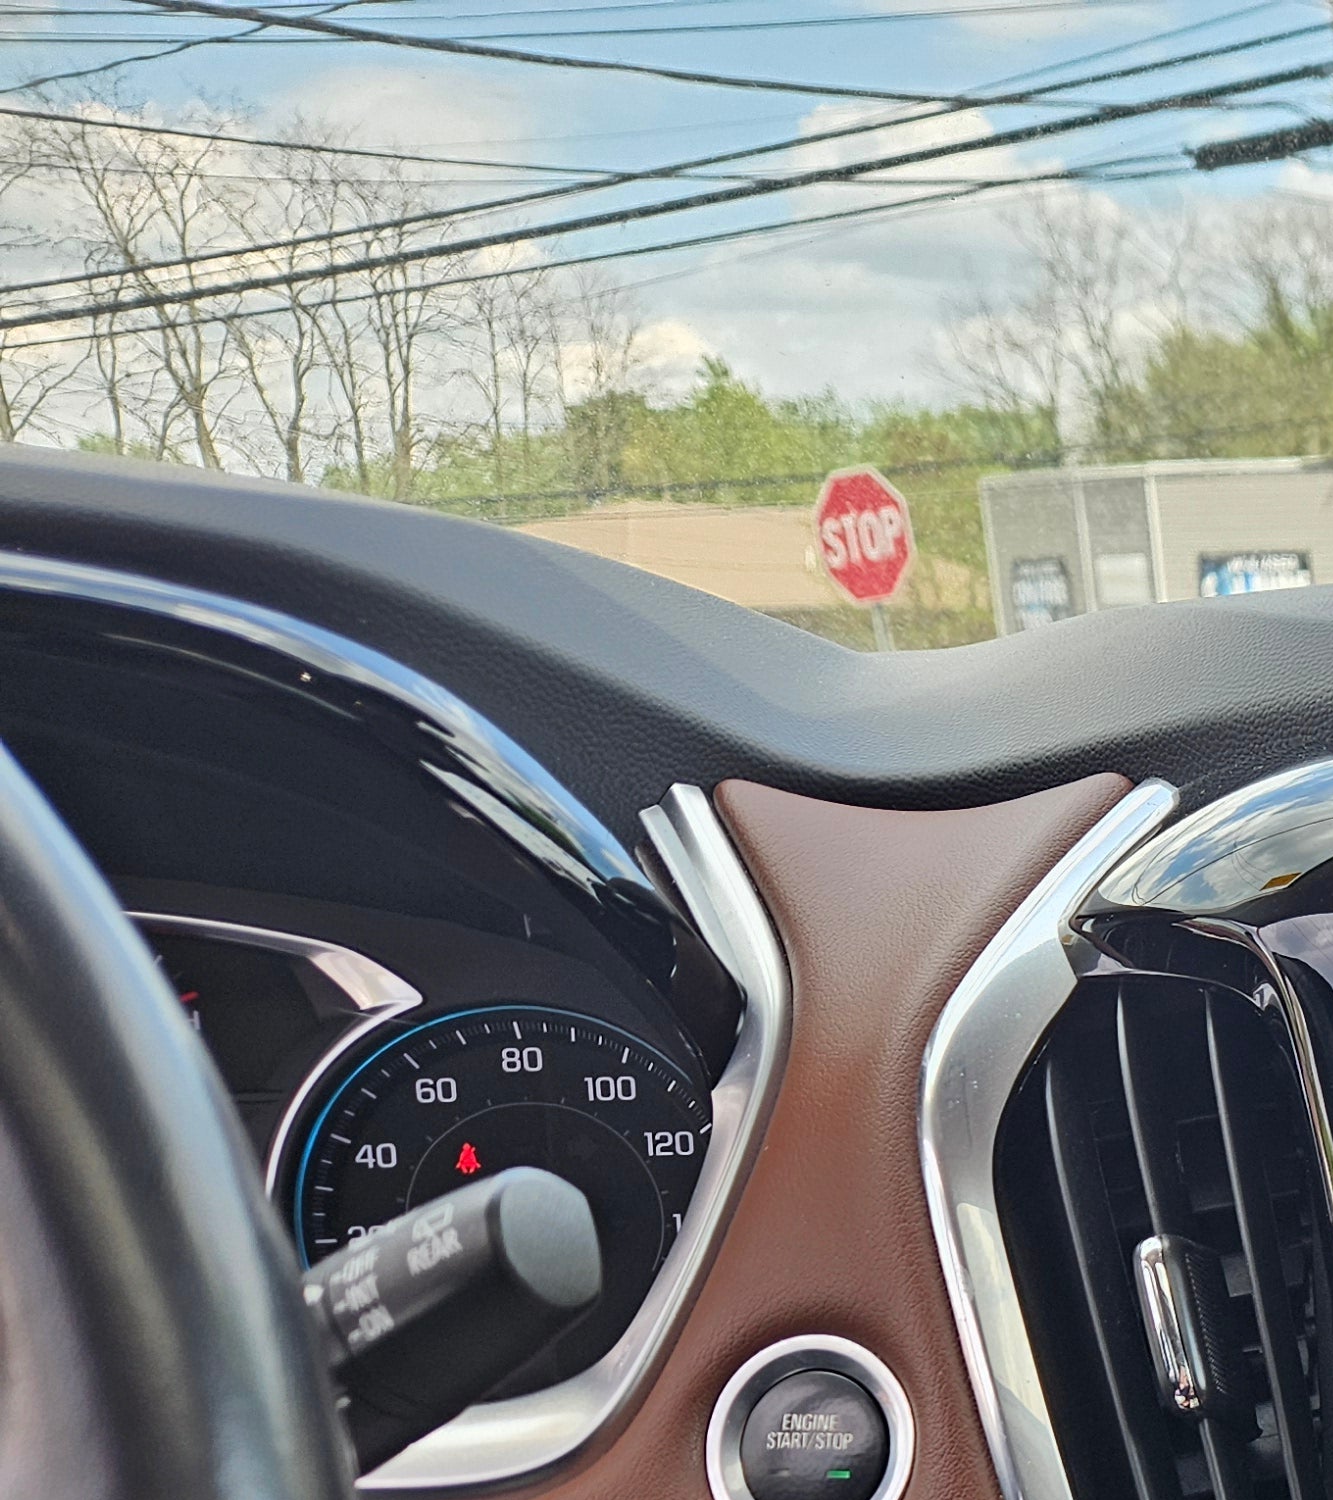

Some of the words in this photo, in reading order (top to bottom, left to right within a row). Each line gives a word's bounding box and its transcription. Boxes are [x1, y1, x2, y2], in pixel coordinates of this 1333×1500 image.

[819, 506, 901, 566] STOP
[500, 1047, 543, 1073] 80
[414, 1077, 458, 1104] 60
[583, 1075, 637, 1101] 100
[354, 1142, 397, 1169] 40
[643, 1129, 695, 1157] 120
[781, 1413, 840, 1431] ENGINE
[766, 1431, 854, 1451] START/STOP
